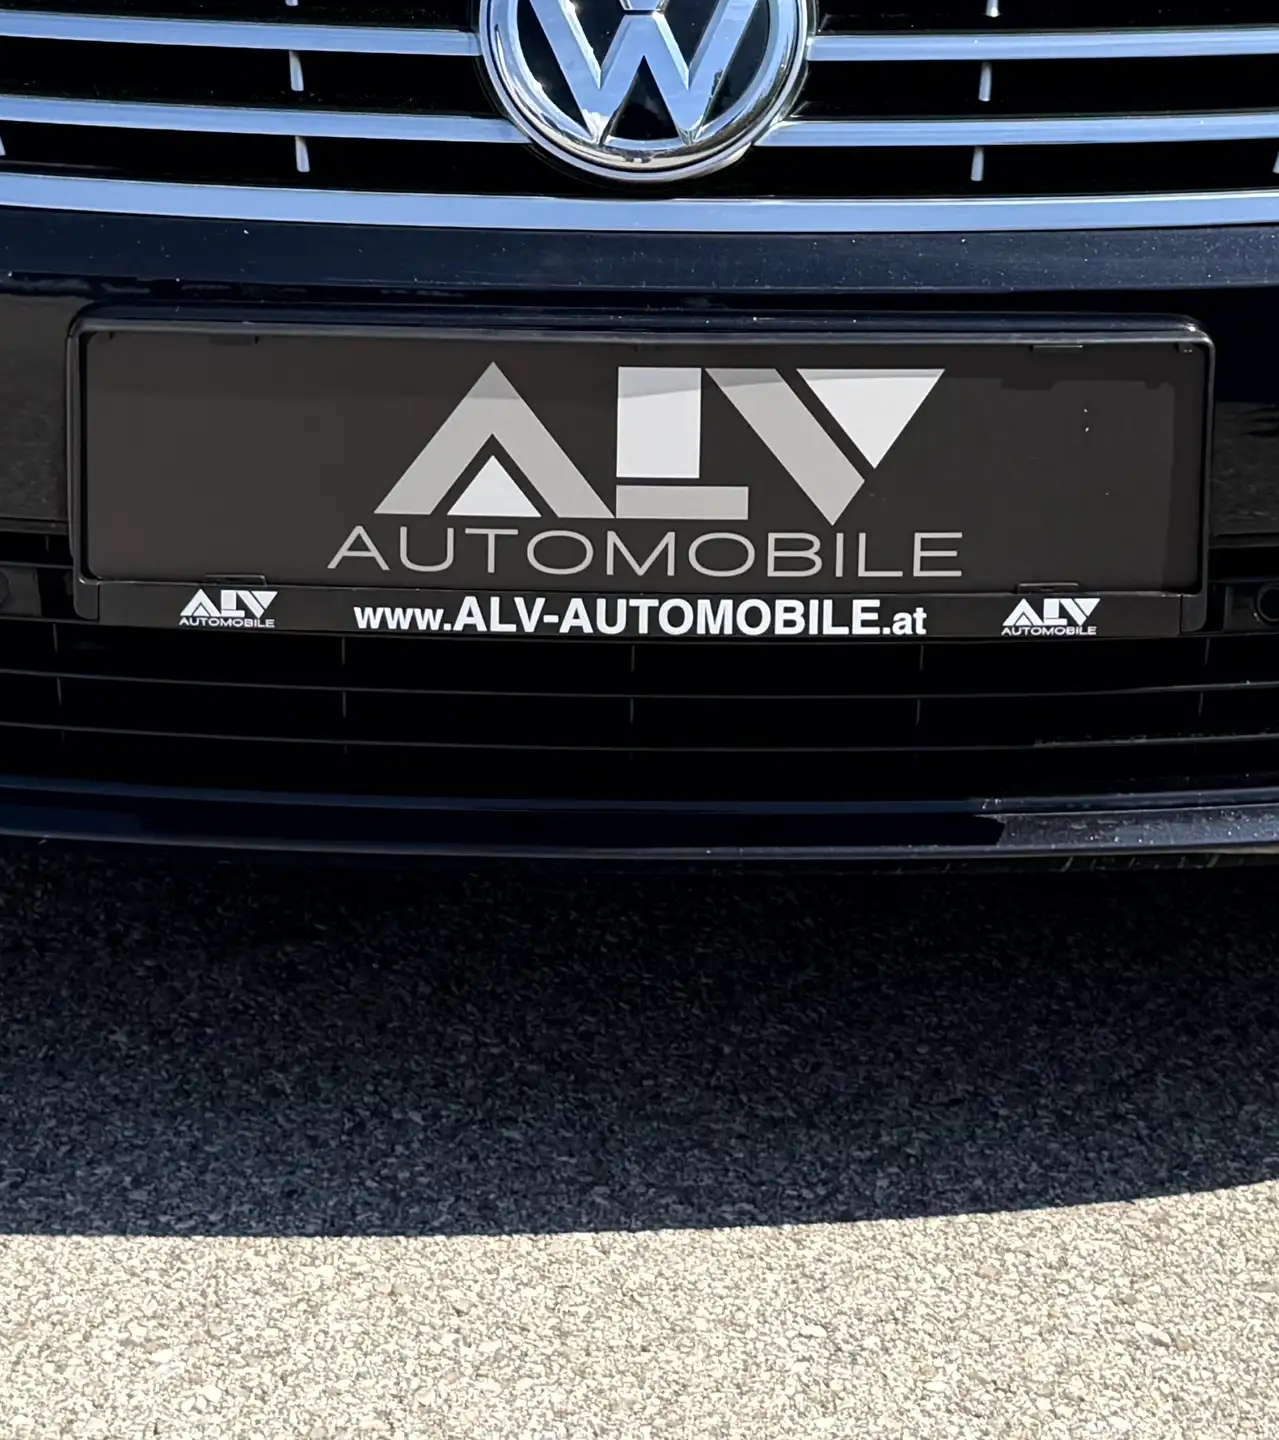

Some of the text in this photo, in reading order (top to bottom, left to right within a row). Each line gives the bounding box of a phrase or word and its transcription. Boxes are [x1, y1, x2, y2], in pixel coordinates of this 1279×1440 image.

[373, 361, 946, 527] ALV
[326, 524, 964, 578] AUTOMOBILE
[179, 588, 278, 619] ALV
[353, 595, 928, 636] www.ALV-AUTOMOBILE.at
[1002, 598, 1101, 627] ALV
[178, 616, 276, 629] AUTOMOBILE
[1000, 626, 1098, 637] AUTOMOBILE
